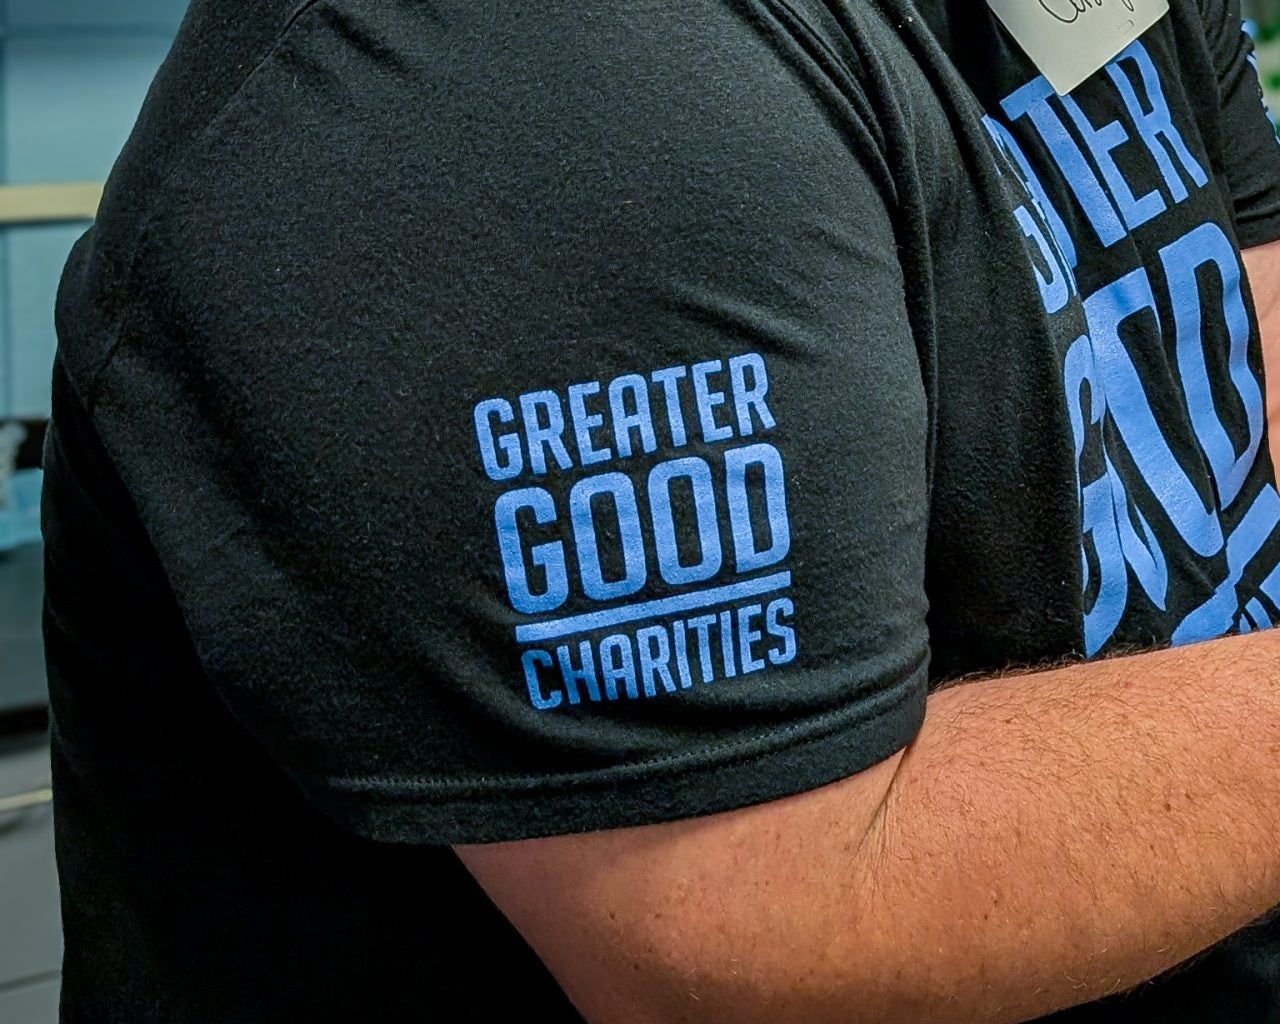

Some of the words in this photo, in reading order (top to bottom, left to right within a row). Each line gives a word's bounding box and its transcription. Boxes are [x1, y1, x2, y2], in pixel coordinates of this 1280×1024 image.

[473, 352, 777, 481] GREATER
[493, 442, 791, 615] GOOD
[520, 597, 797, 711] CHARITIES
